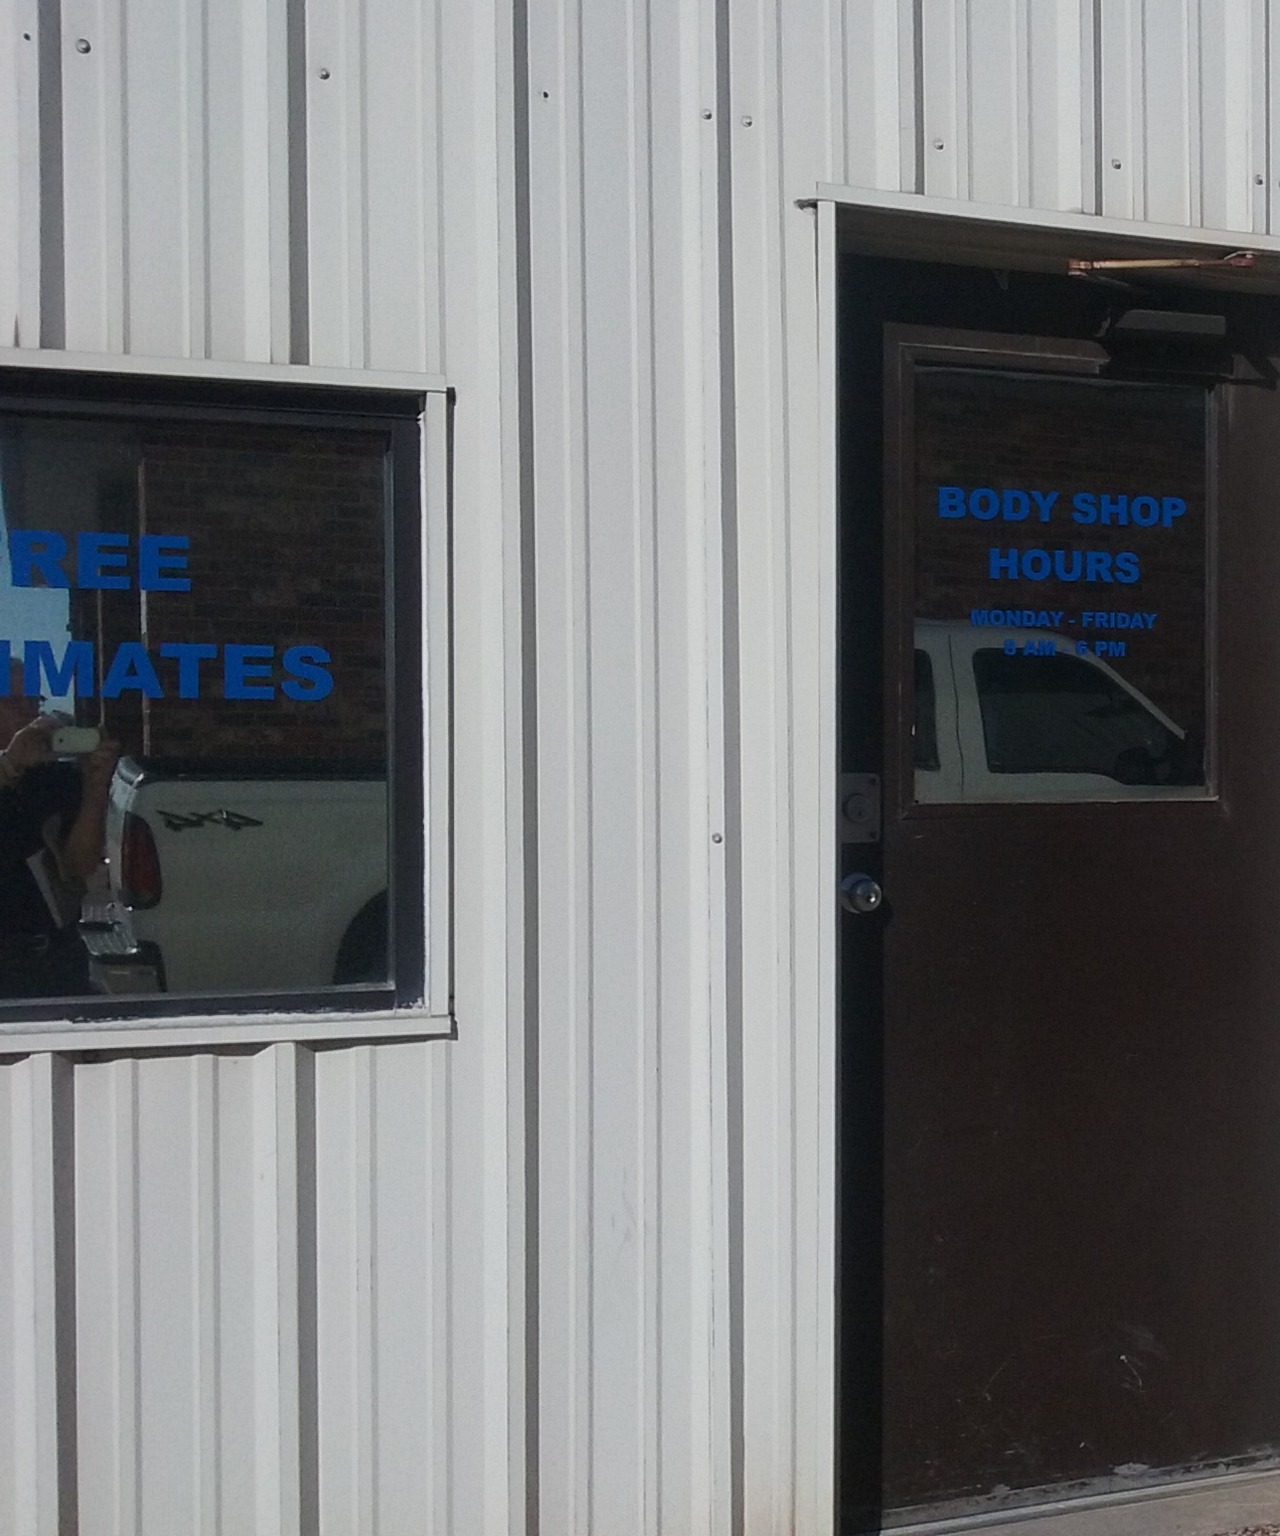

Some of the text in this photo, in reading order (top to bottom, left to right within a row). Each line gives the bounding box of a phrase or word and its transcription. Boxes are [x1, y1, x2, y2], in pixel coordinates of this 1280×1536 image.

[938, 486, 1187, 528] BODY SHOP
[988, 548, 1141, 584] HOURS
[970, 609, 1064, 627] MONDAY
[1081, 611, 1157, 629] FRIDAY
[1023, 638, 1058, 657] AM
[1094, 640, 1127, 657] PM
